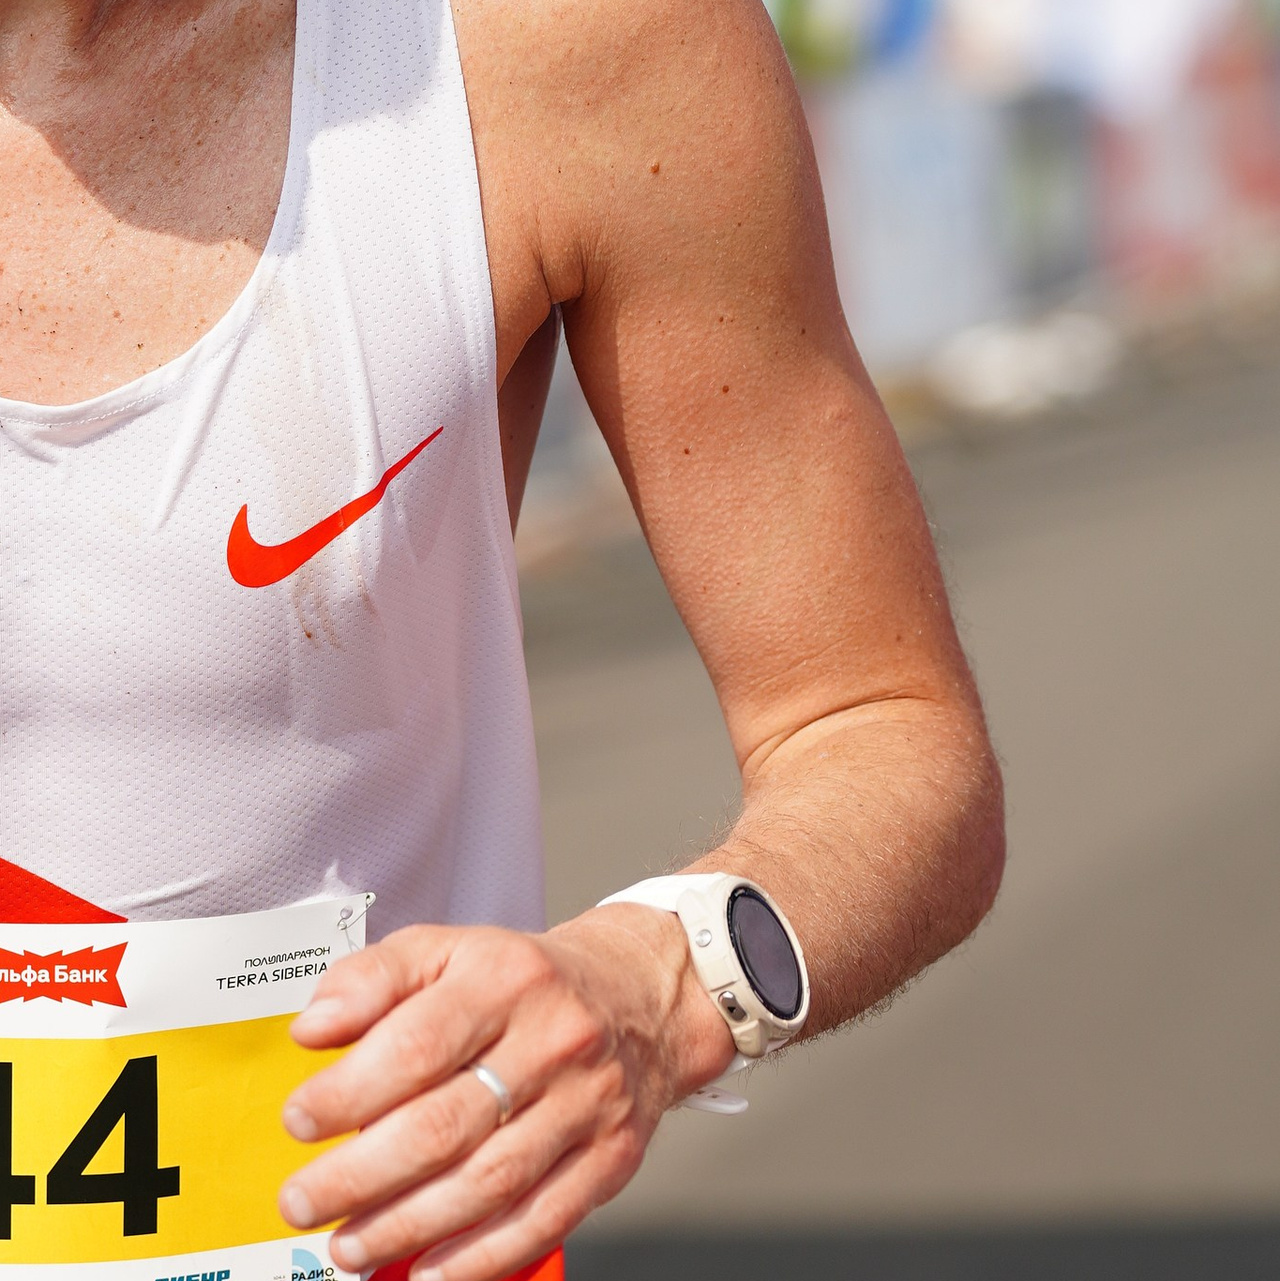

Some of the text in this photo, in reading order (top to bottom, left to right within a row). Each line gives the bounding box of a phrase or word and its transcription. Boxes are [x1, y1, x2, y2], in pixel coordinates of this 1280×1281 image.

[244, 946, 331, 968] ПОЛУМАРАФОН
[54, 964, 108, 983] Банк
[216, 962, 327, 990] TERRA SIBERIA
[291, 1267, 335, 1281] РАДИО
